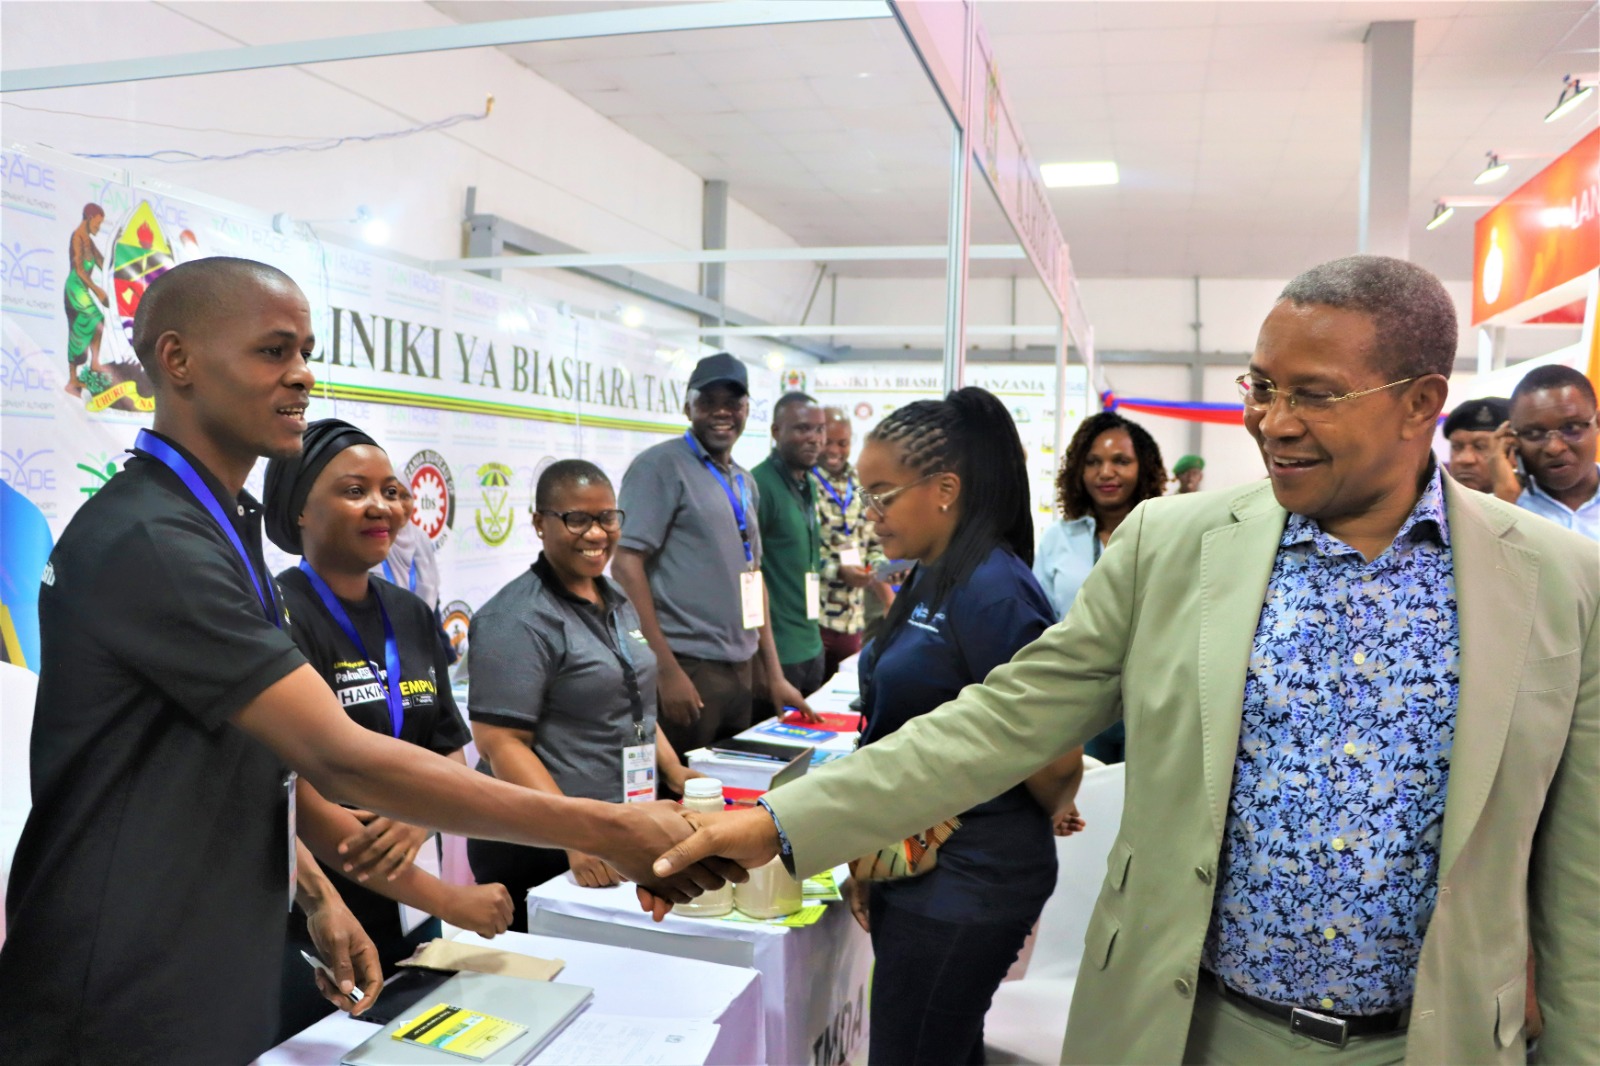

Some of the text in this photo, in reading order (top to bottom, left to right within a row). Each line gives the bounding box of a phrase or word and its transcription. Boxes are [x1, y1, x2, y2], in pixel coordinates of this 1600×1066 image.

[454, 331, 502, 389] YA
[511, 344, 639, 410] BIASHARA
[421, 494, 437, 510] tbs
